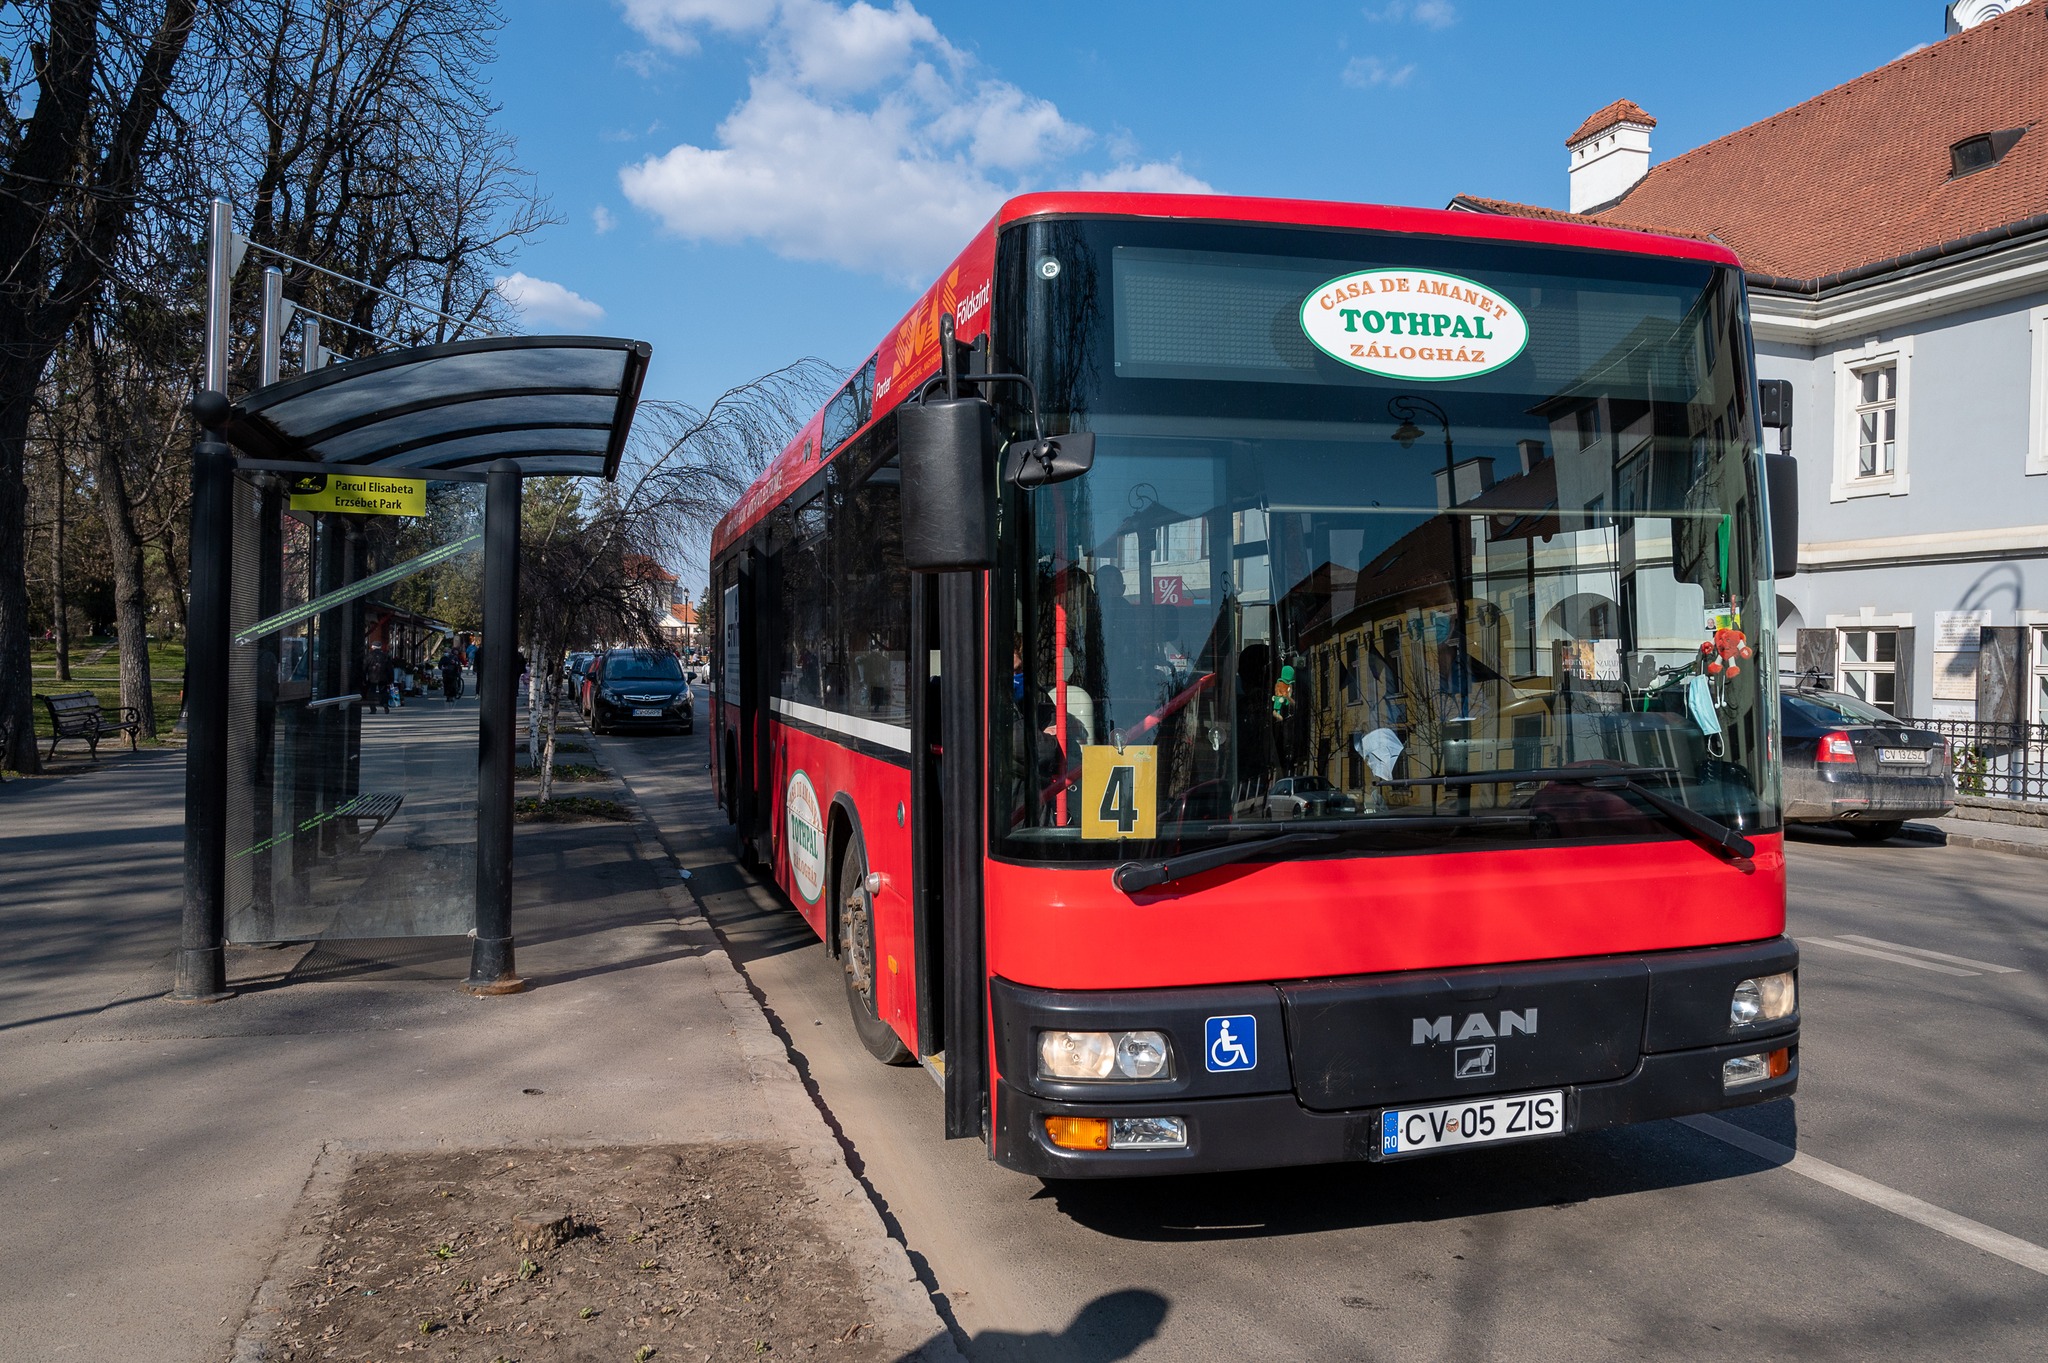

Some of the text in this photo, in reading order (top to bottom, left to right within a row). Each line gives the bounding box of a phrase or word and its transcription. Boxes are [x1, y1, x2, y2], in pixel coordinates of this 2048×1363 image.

[956, 278, 990, 330] Földszint
[1320, 278, 1508, 321] CASA DE AMANET
[1339, 308, 1493, 340] TOTHPAL
[1350, 341, 1486, 363] ZÁLOGHÁZ
[875, 375, 892, 402] Parter
[335, 480, 414, 495] Parcul Elisabeta
[335, 496, 402, 510] Erzsébet Park
[1884, 750, 1896, 760] CV
[1099, 766, 1139, 833] 4
[791, 814, 819, 860] TOTHPAL
[1412, 1007, 1538, 1045] MAN
[1405, 1098, 1555, 1145] CV 05 ZIS
[1384, 1135, 1397, 1149] RO
